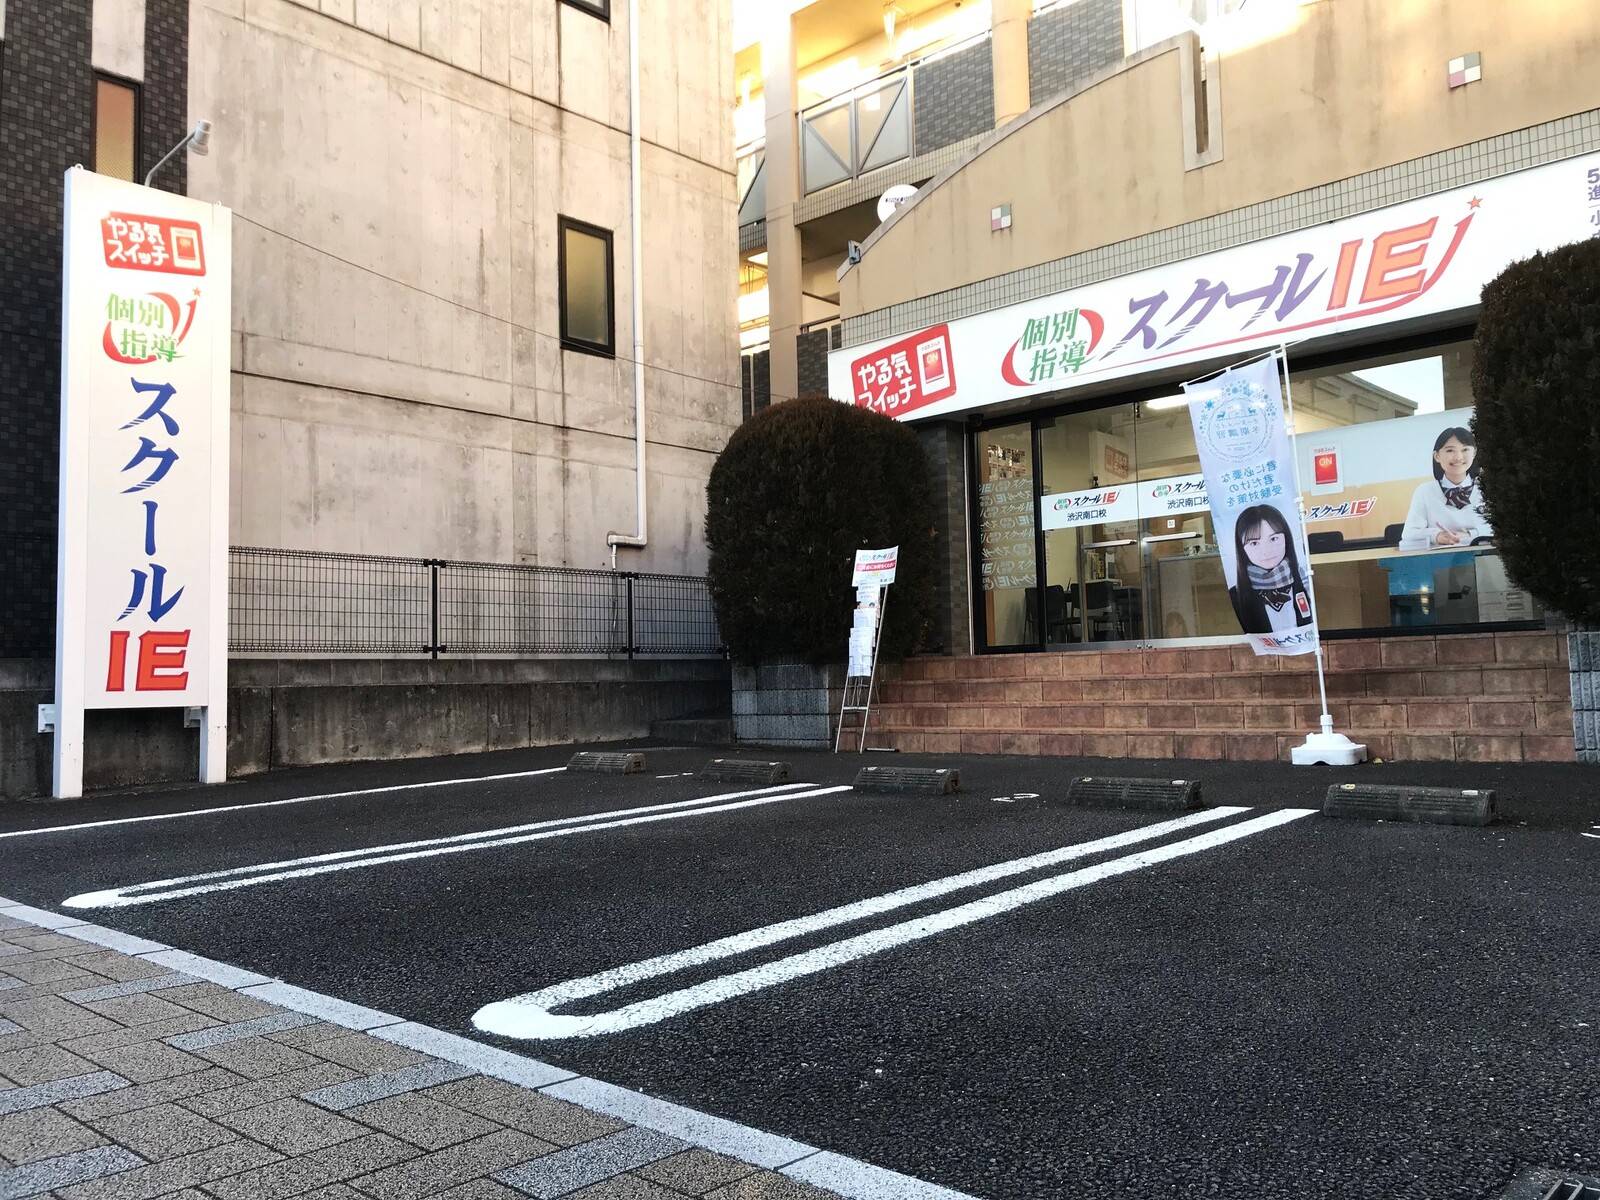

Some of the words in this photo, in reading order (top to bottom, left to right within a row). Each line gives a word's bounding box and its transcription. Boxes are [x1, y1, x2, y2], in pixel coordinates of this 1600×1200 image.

[107, 217, 165, 246] やる気
[108, 239, 170, 267] スイッチ
[1100, 216, 1439, 361] スクールIE
[105, 292, 165, 329] 個別
[119, 327, 180, 363] 指導
[1021, 308, 1080, 352] 個別
[857, 350, 912, 391] やる気
[1028, 340, 1088, 383] 指導
[1066, 508, 1108, 522] 渋沢南口校
[1309, 501, 1370, 518] スクールIE
